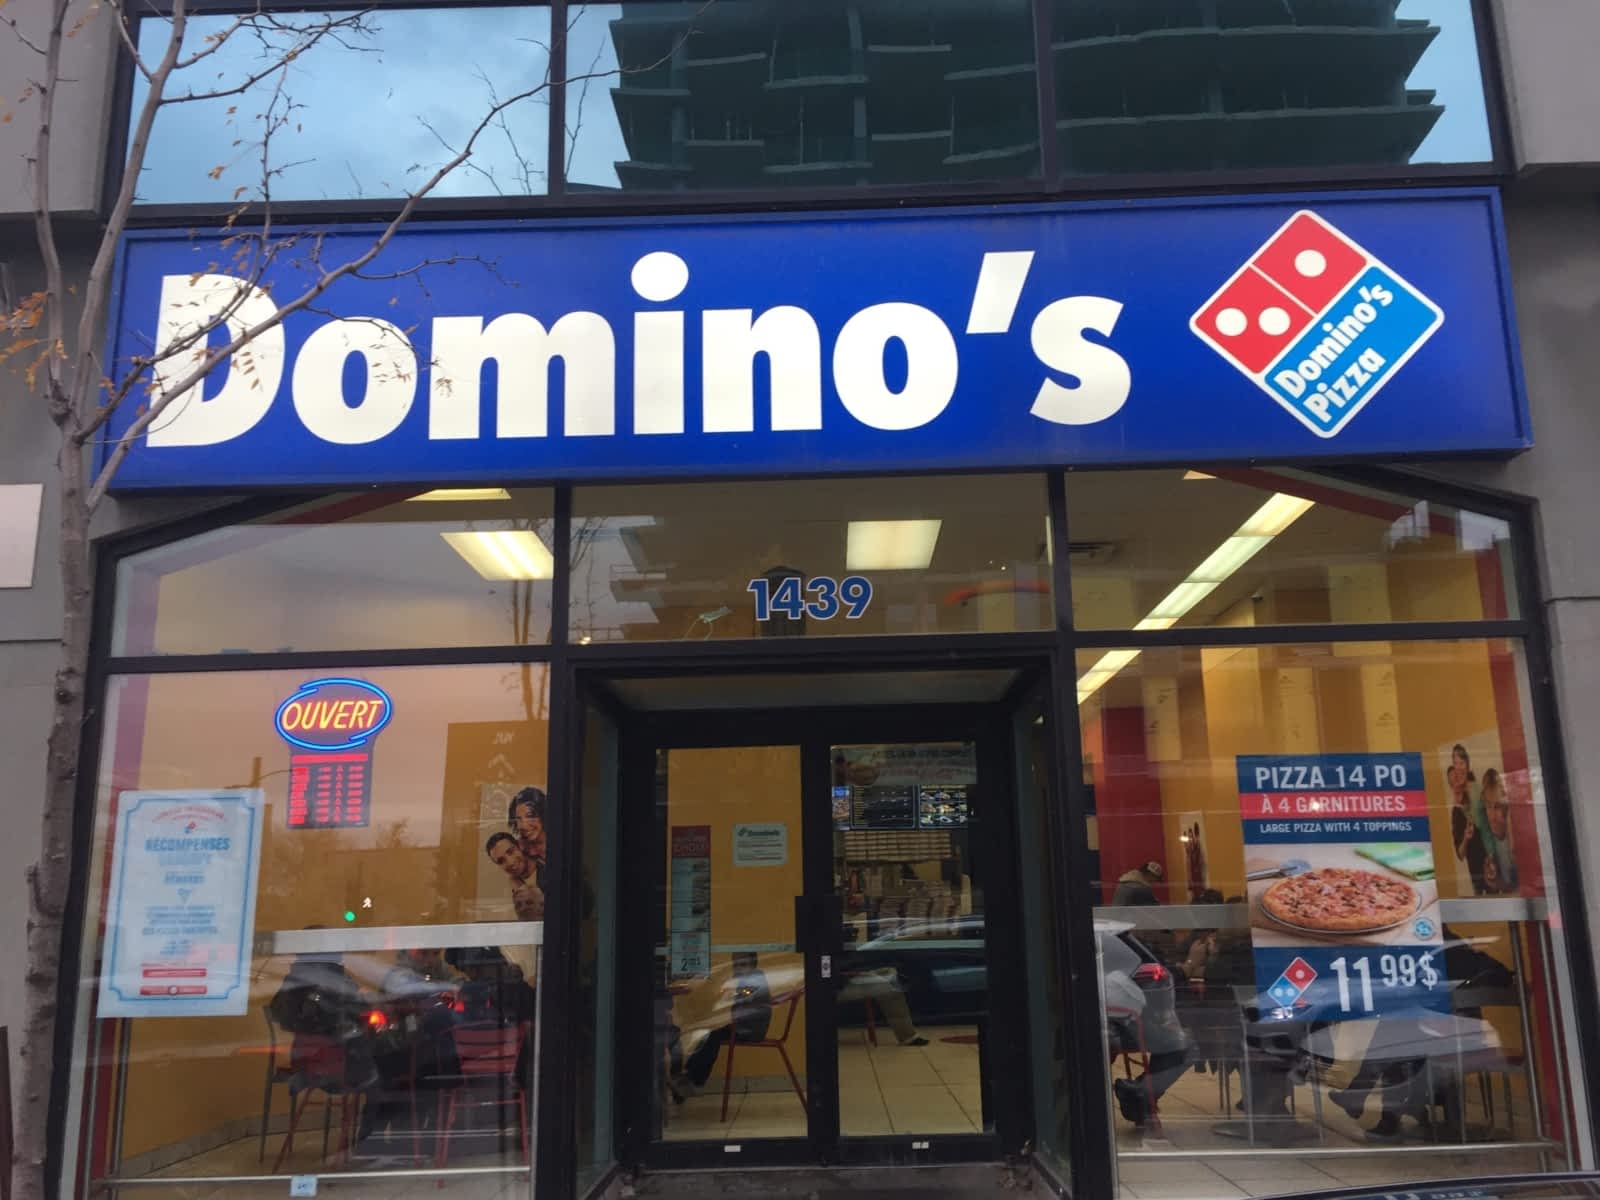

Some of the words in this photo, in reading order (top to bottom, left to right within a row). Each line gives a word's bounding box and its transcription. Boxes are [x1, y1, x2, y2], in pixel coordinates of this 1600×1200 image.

[148, 251, 1132, 448] Domino's
[1273, 284, 1393, 399] Domino's
[1303, 347, 1386, 423] Pizza
[746, 576, 873, 621] 1439
[282, 700, 384, 730] OUVERT
[1255, 765, 1325, 790] PIZZA
[1335, 765, 1367, 788] 14
[1375, 764, 1407, 788] PO
[1261, 793, 1274, 814] À
[1277, 797, 1291, 814] 4
[1296, 795, 1407, 814] GARNITURES
[1260, 822, 1291, 834] LARGE
[1294, 822, 1322, 833] PIZZA
[1324, 822, 1351, 833] WITH
[1352, 822, 1361, 833] 4
[1363, 821, 1413, 833] TOPPINGS
